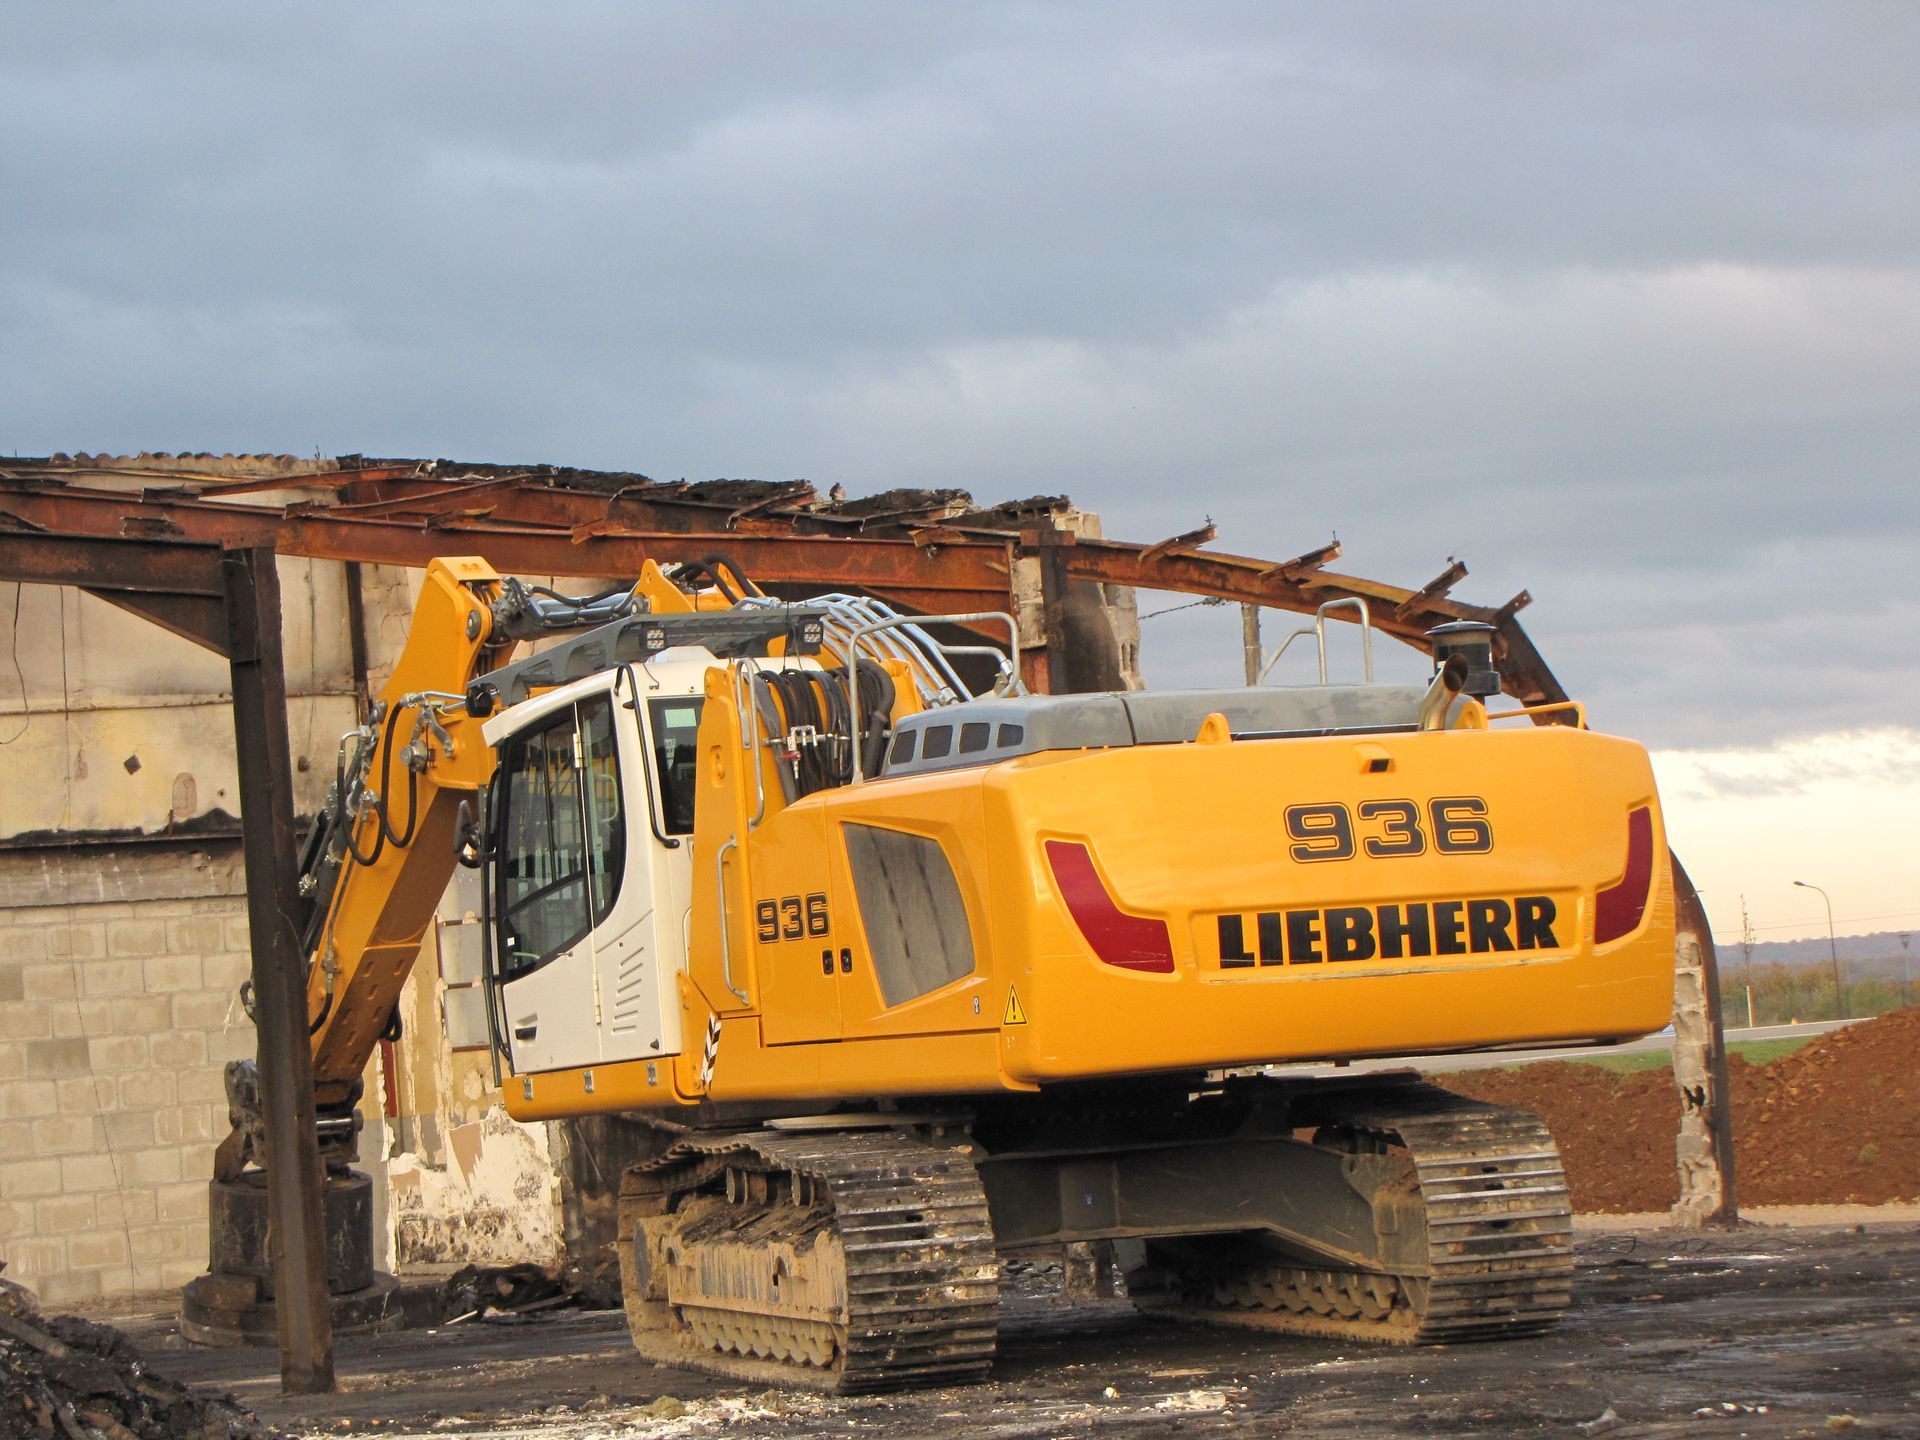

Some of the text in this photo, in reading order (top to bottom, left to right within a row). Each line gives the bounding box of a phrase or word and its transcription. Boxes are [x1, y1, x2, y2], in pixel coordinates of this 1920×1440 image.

[1284, 796, 1493, 863] 936
[756, 892, 830, 944] 936
[1217, 896, 1560, 969] LIEBHERR
